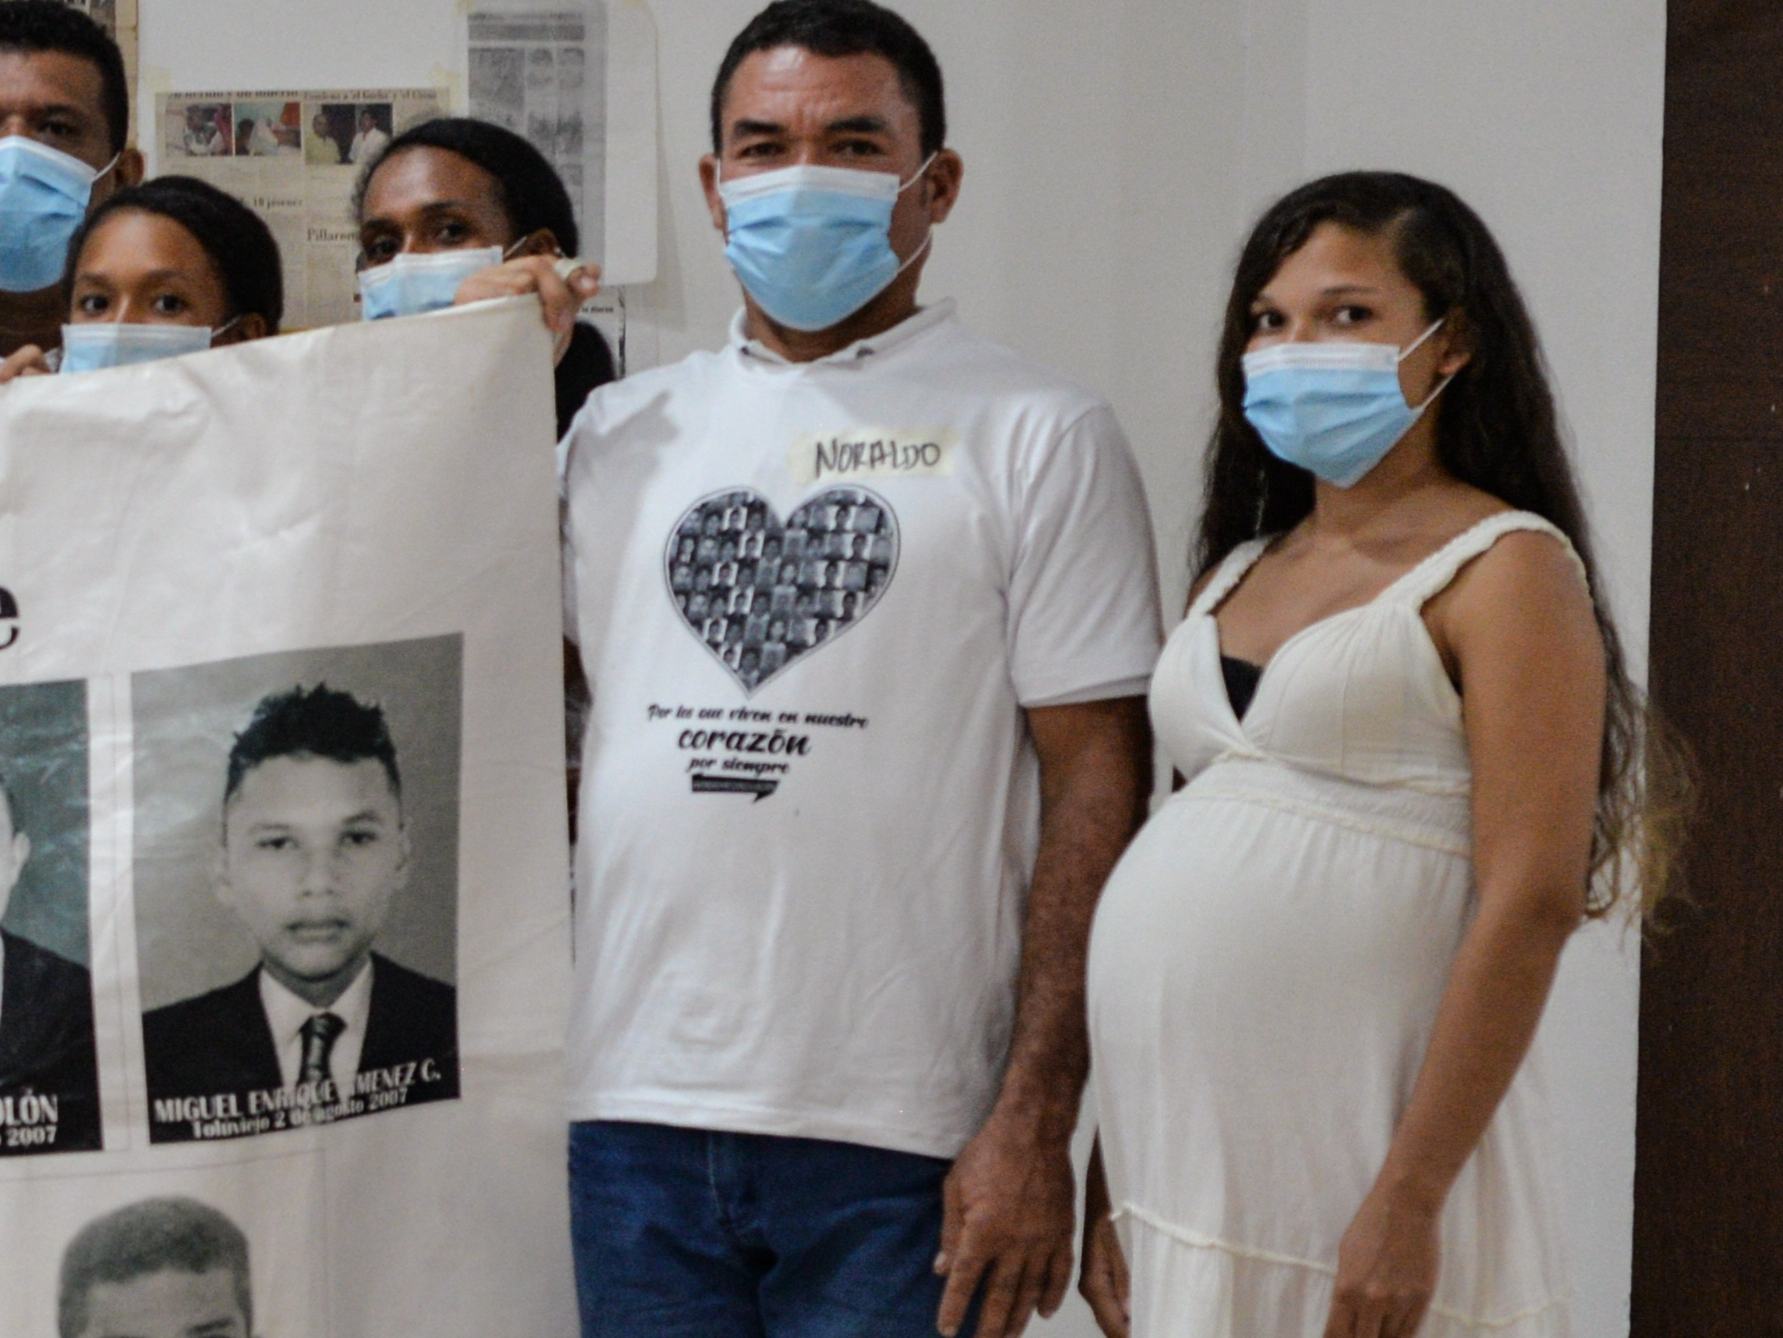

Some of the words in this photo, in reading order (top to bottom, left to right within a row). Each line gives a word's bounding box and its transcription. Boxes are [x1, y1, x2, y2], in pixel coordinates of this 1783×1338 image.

[686, 757, 718, 773] por
[721, 757, 790, 776] siempre
[154, 1094, 241, 1125] MIGUEL
[420, 1058, 442, 1083] C.
[275, 1114, 286, 1129] 2
[368, 1087, 409, 1111] 2007
[7, 1126, 58, 1148] 2007
